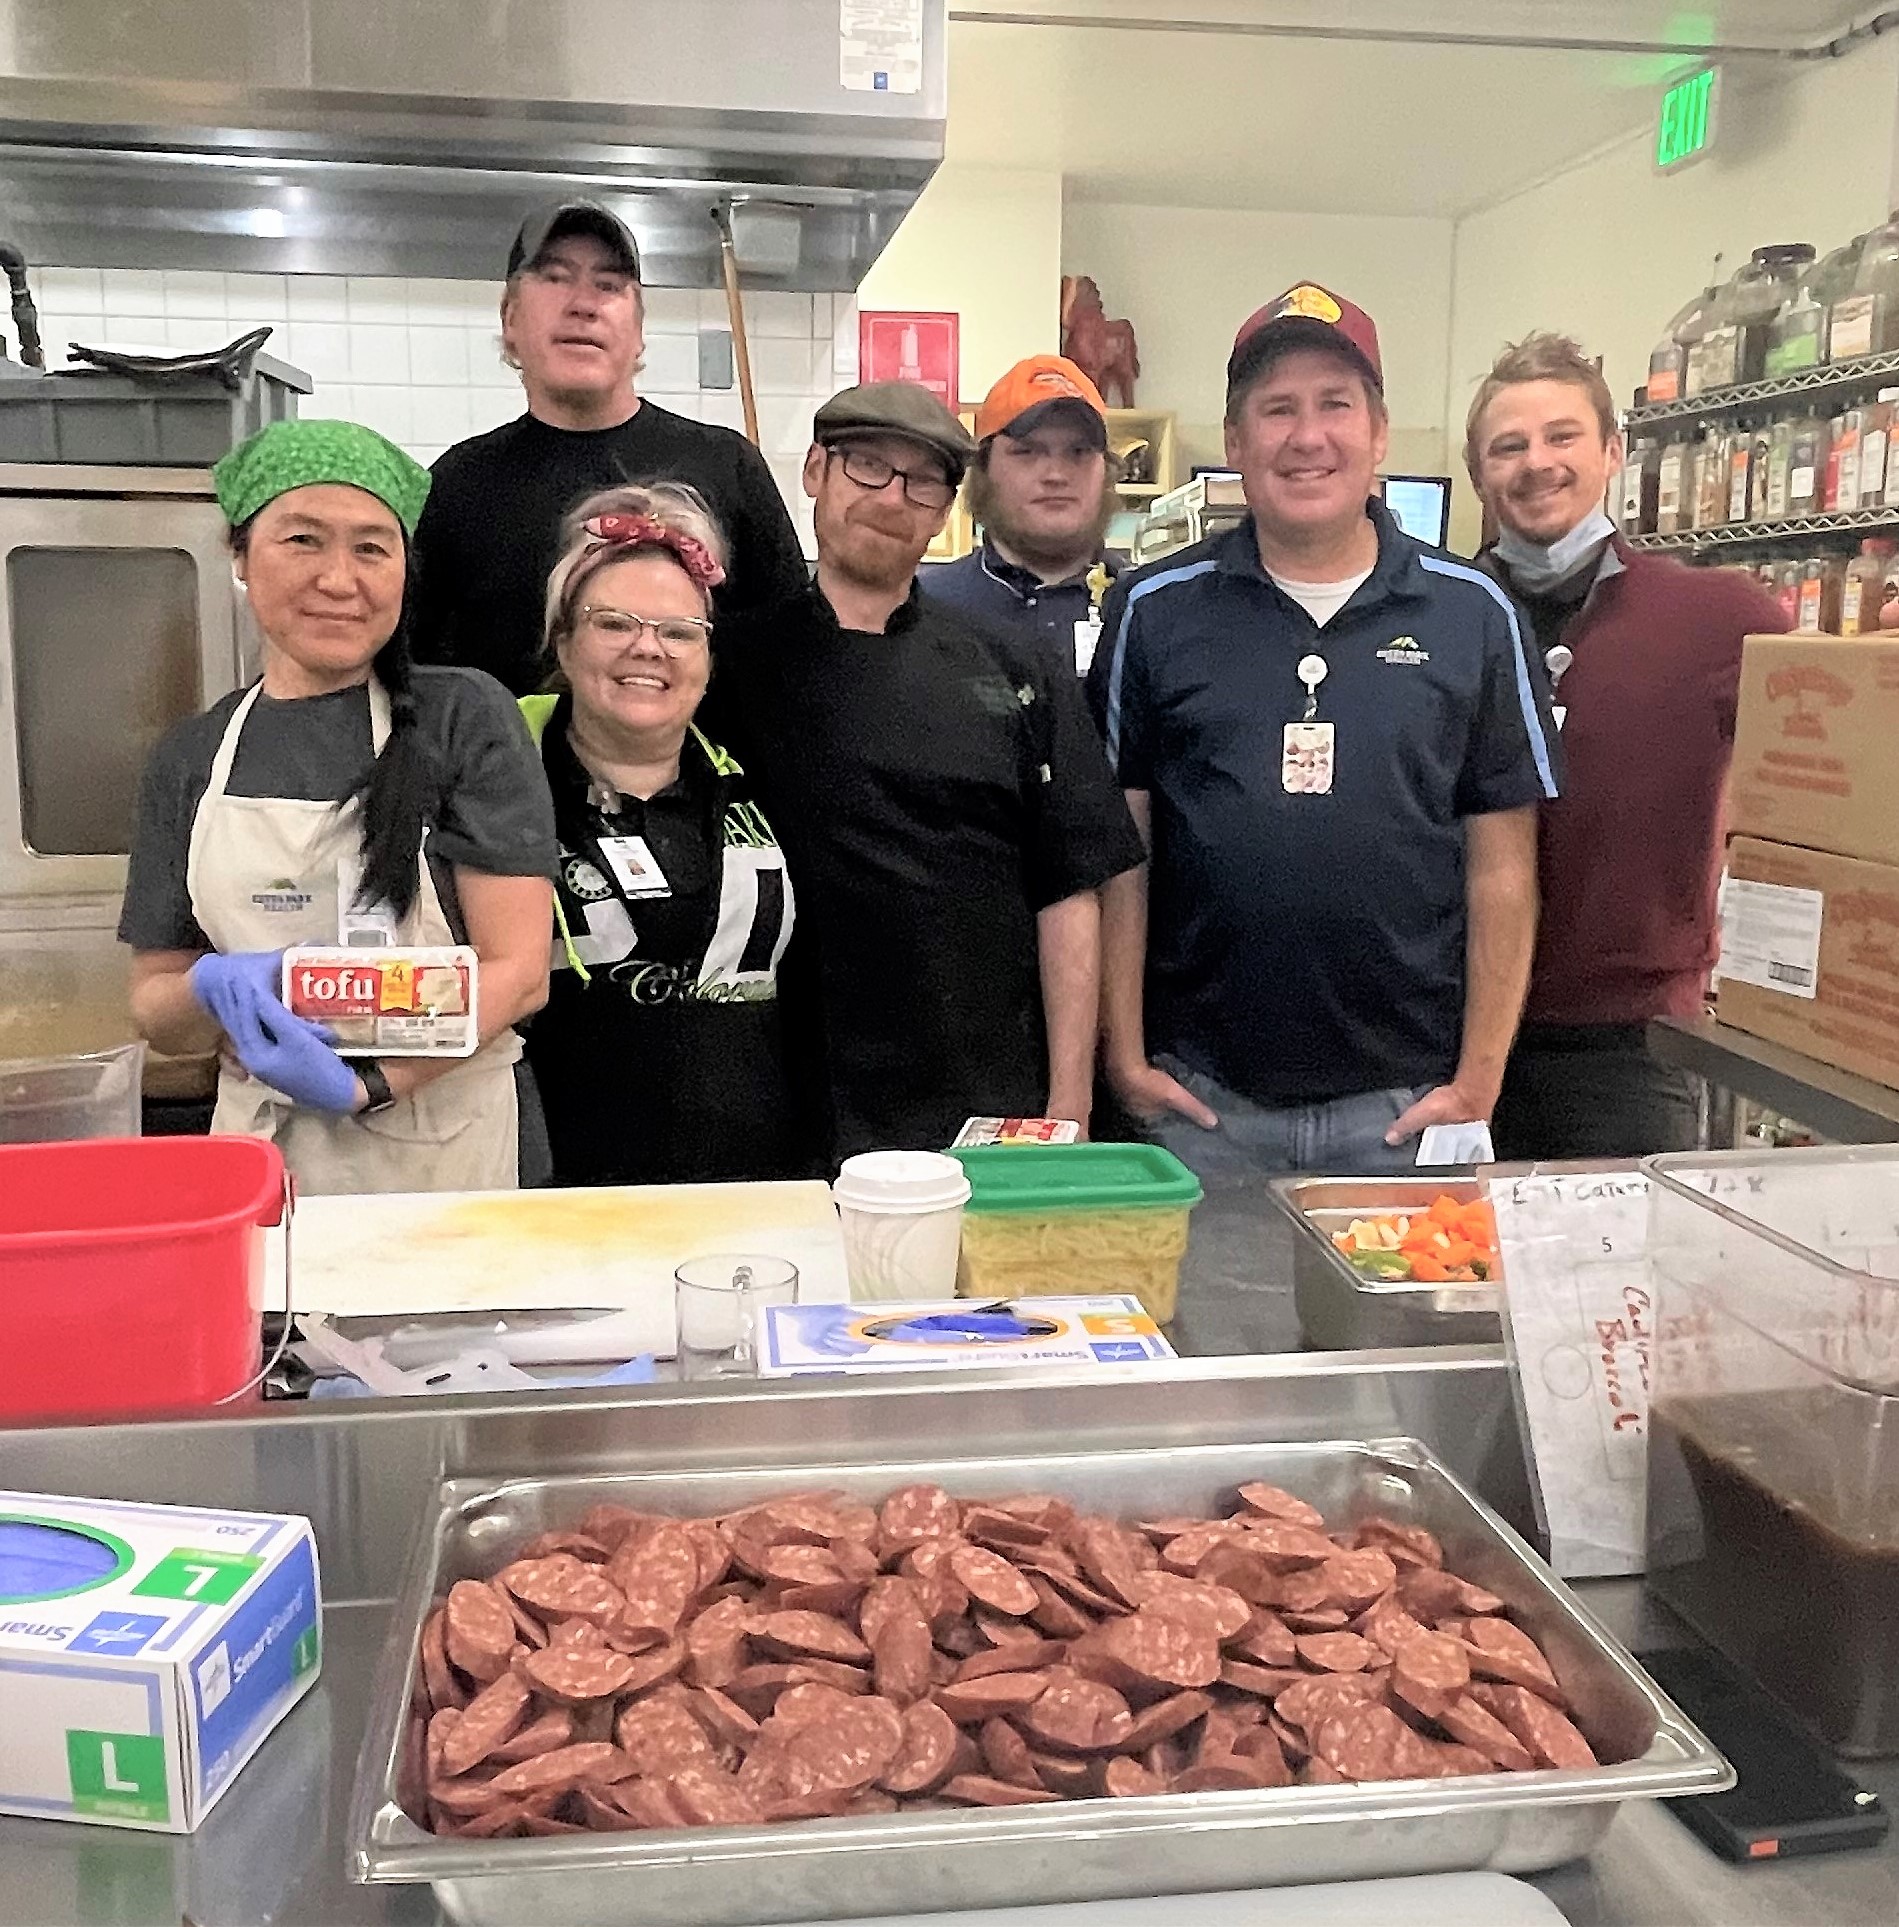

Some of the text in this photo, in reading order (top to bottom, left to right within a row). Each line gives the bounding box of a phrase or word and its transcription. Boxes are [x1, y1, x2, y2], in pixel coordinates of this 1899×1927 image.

[1657, 70, 1714, 166] EXIT
[301, 969, 375, 1001] tofu
[1601, 1236, 1613, 1253] 5
[1104, 1318, 1137, 1333] S
[183, 1564, 220, 1596] L
[101, 1740, 140, 1793] L
